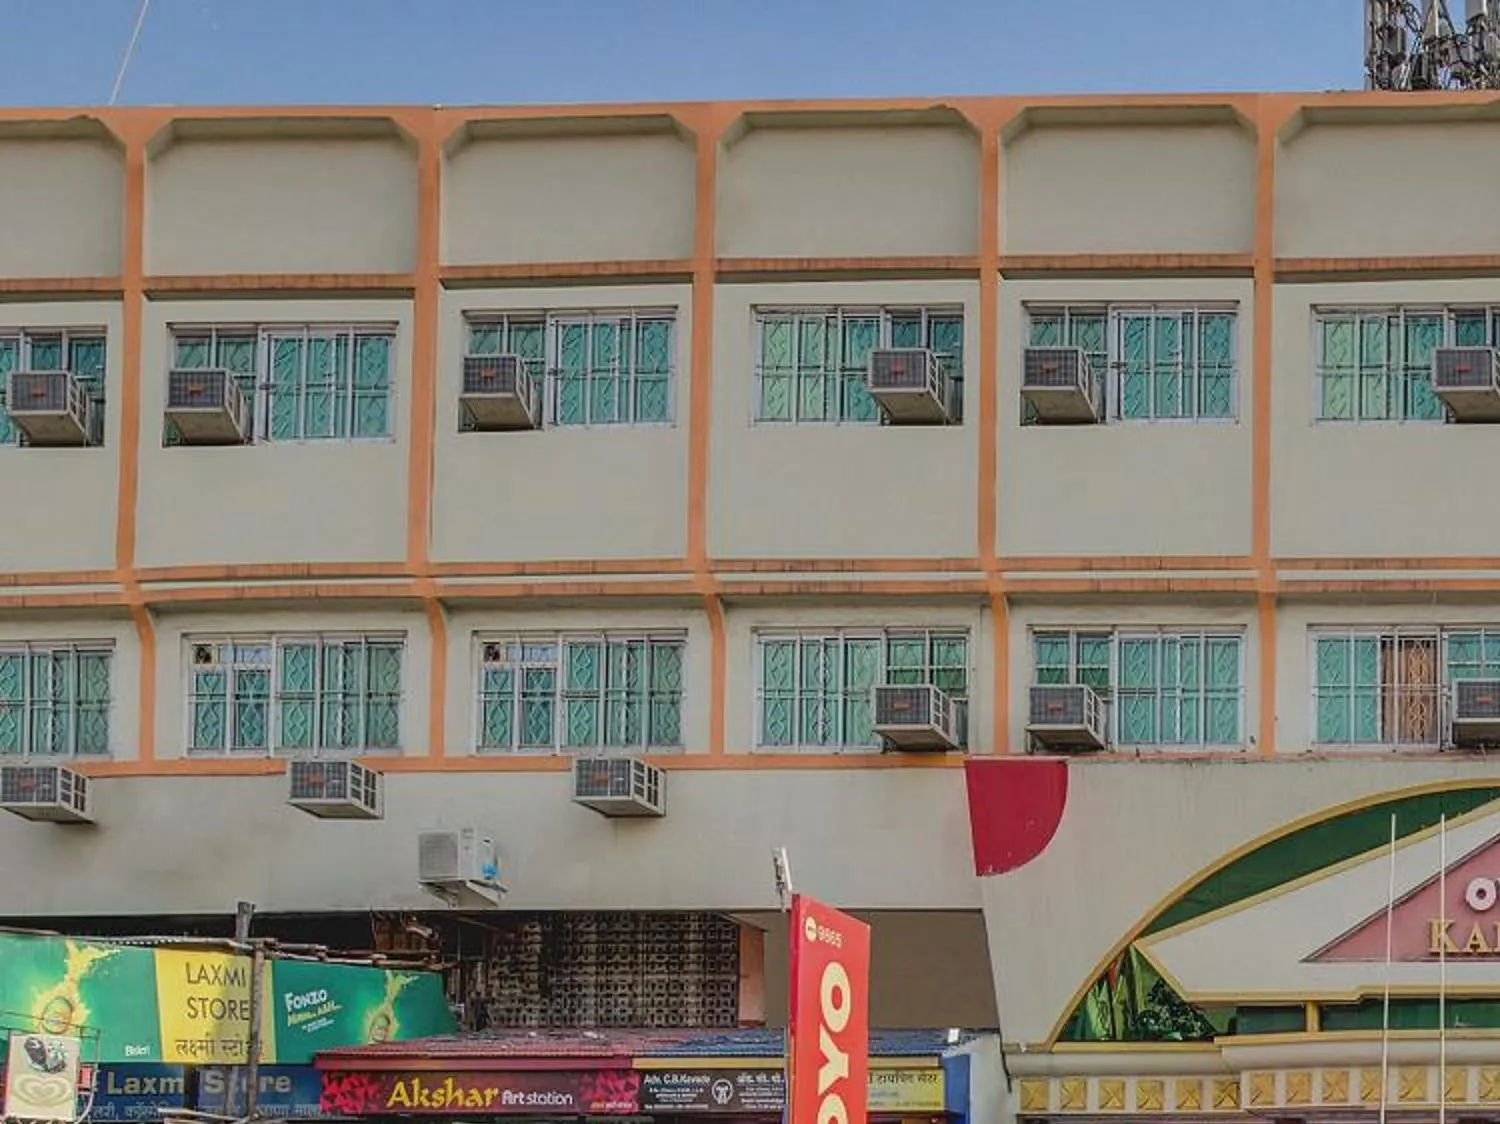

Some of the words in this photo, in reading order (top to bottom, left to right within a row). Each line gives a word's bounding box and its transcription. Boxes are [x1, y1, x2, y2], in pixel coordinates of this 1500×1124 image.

[186, 962, 247, 987] LAXMI
[107, 1072, 184, 1095] Laxm
[203, 1070, 292, 1094] Sre
[387, 1076, 500, 1109] Akshar
[502, 1089, 525, 1105] Art
[526, 1090, 573, 1105] station
